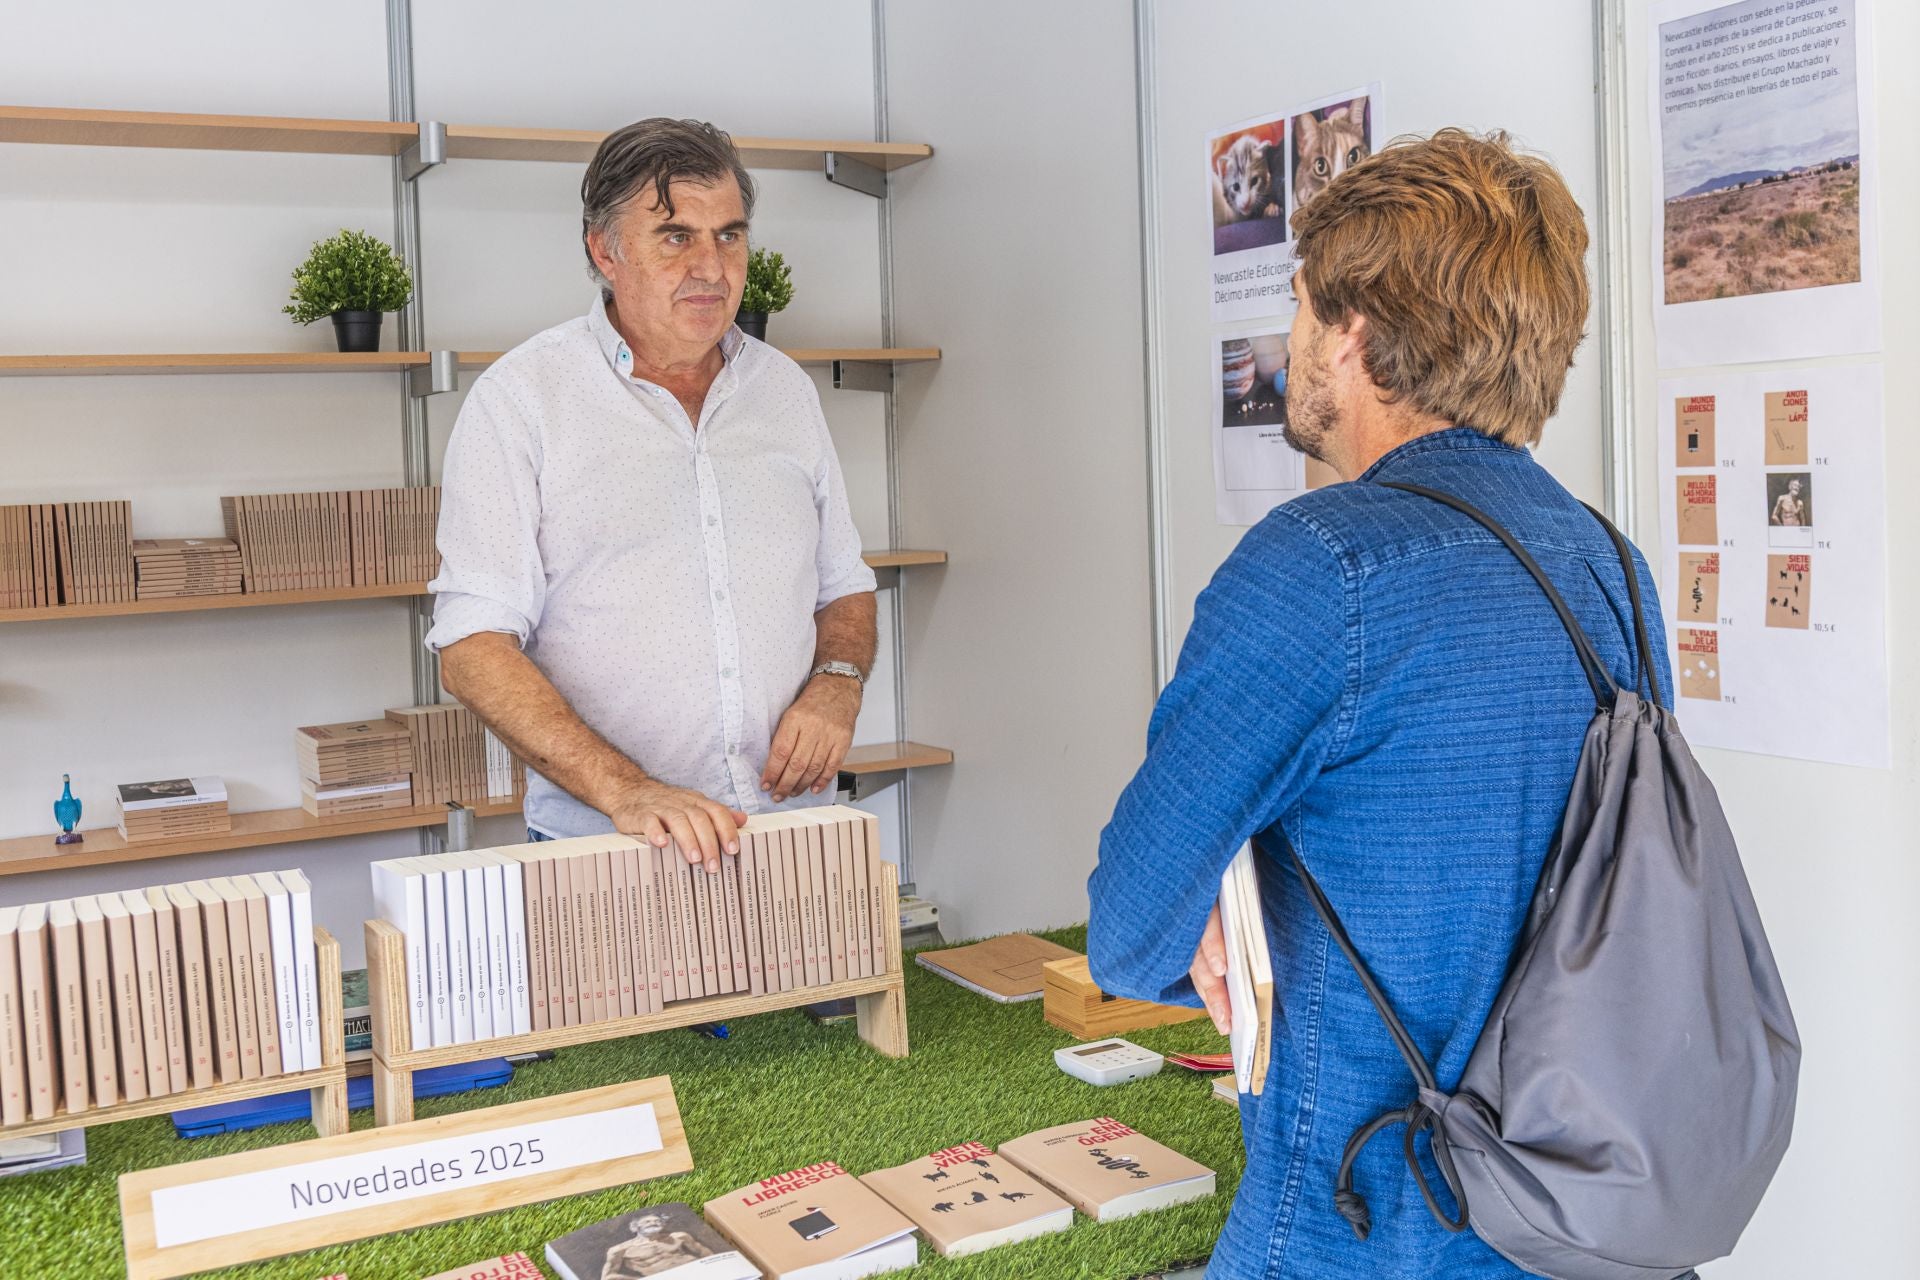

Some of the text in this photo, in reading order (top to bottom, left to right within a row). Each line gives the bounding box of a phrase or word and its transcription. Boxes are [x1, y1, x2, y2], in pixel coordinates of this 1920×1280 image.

[1665, 27, 1702, 42] Newcastle
[1704, 17, 1738, 31] ediciones
[1740, 14, 1753, 22] con
[1755, 8, 1773, 18] sede
[1776, 4, 1784, 13] en
[1787, 2, 1794, 10] la
[1702, 38, 1712, 47] los
[1714, 34, 1729, 45] pies
[1731, 30, 1740, 40] de
[1742, 28, 1748, 36] la
[1751, 23, 1772, 35] sierra
[1774, 20, 1784, 29] de
[1828, 6, 1838, 14] se
[1688, 56, 1697, 66] en
[1698, 54, 1706, 63] el
[1707, 50, 1720, 61] año
[1722, 46, 1740, 57] 2015
[1747, 42, 1756, 50] se
[1758, 35, 1783, 48] dedica
[1792, 19, 1846, 40] publicaciones
[1665, 76, 1674, 86] de
[1675, 74, 1684, 82] no
[1778, 46, 1800, 58] libros
[1802, 43, 1811, 52] de
[1814, 38, 1832, 49] viaje
[1698, 82, 1712, 92] Nos
[1714, 73, 1750, 88] distribuye
[1752, 70, 1759, 79] el
[1762, 65, 1785, 76] Grupo
[1787, 55, 1824, 70] Machado
[1665, 100, 1697, 114] tenemos
[1698, 92, 1734, 108] presencia
[1736, 88, 1745, 98] en
[1747, 82, 1778, 94] librerías
[1780, 78, 1790, 88] de
[1792, 74, 1810, 85] todo
[1812, 71, 1819, 80] el
[1214, 261, 1295, 284] Newcastle Ediciones
[1214, 282, 1290, 304] Décimo aniversario
[1783, 398, 1808, 406] CIONES
[1789, 412, 1808, 422] LÁPIZ
[1787, 563, 1809, 572] VIDAS
[1678, 643, 1718, 654] BIBLIOTECAS
[930, 1141, 986, 1160] SIETE
[934, 1148, 994, 1168] VIDAS
[290, 1138, 544, 1208] Novedades 2025
[759, 1160, 837, 1189] MUNDO
[742, 1168, 848, 1206] LIBRESCO
[500, 1251, 528, 1264] EL
[503, 1261, 536, 1273] DE
